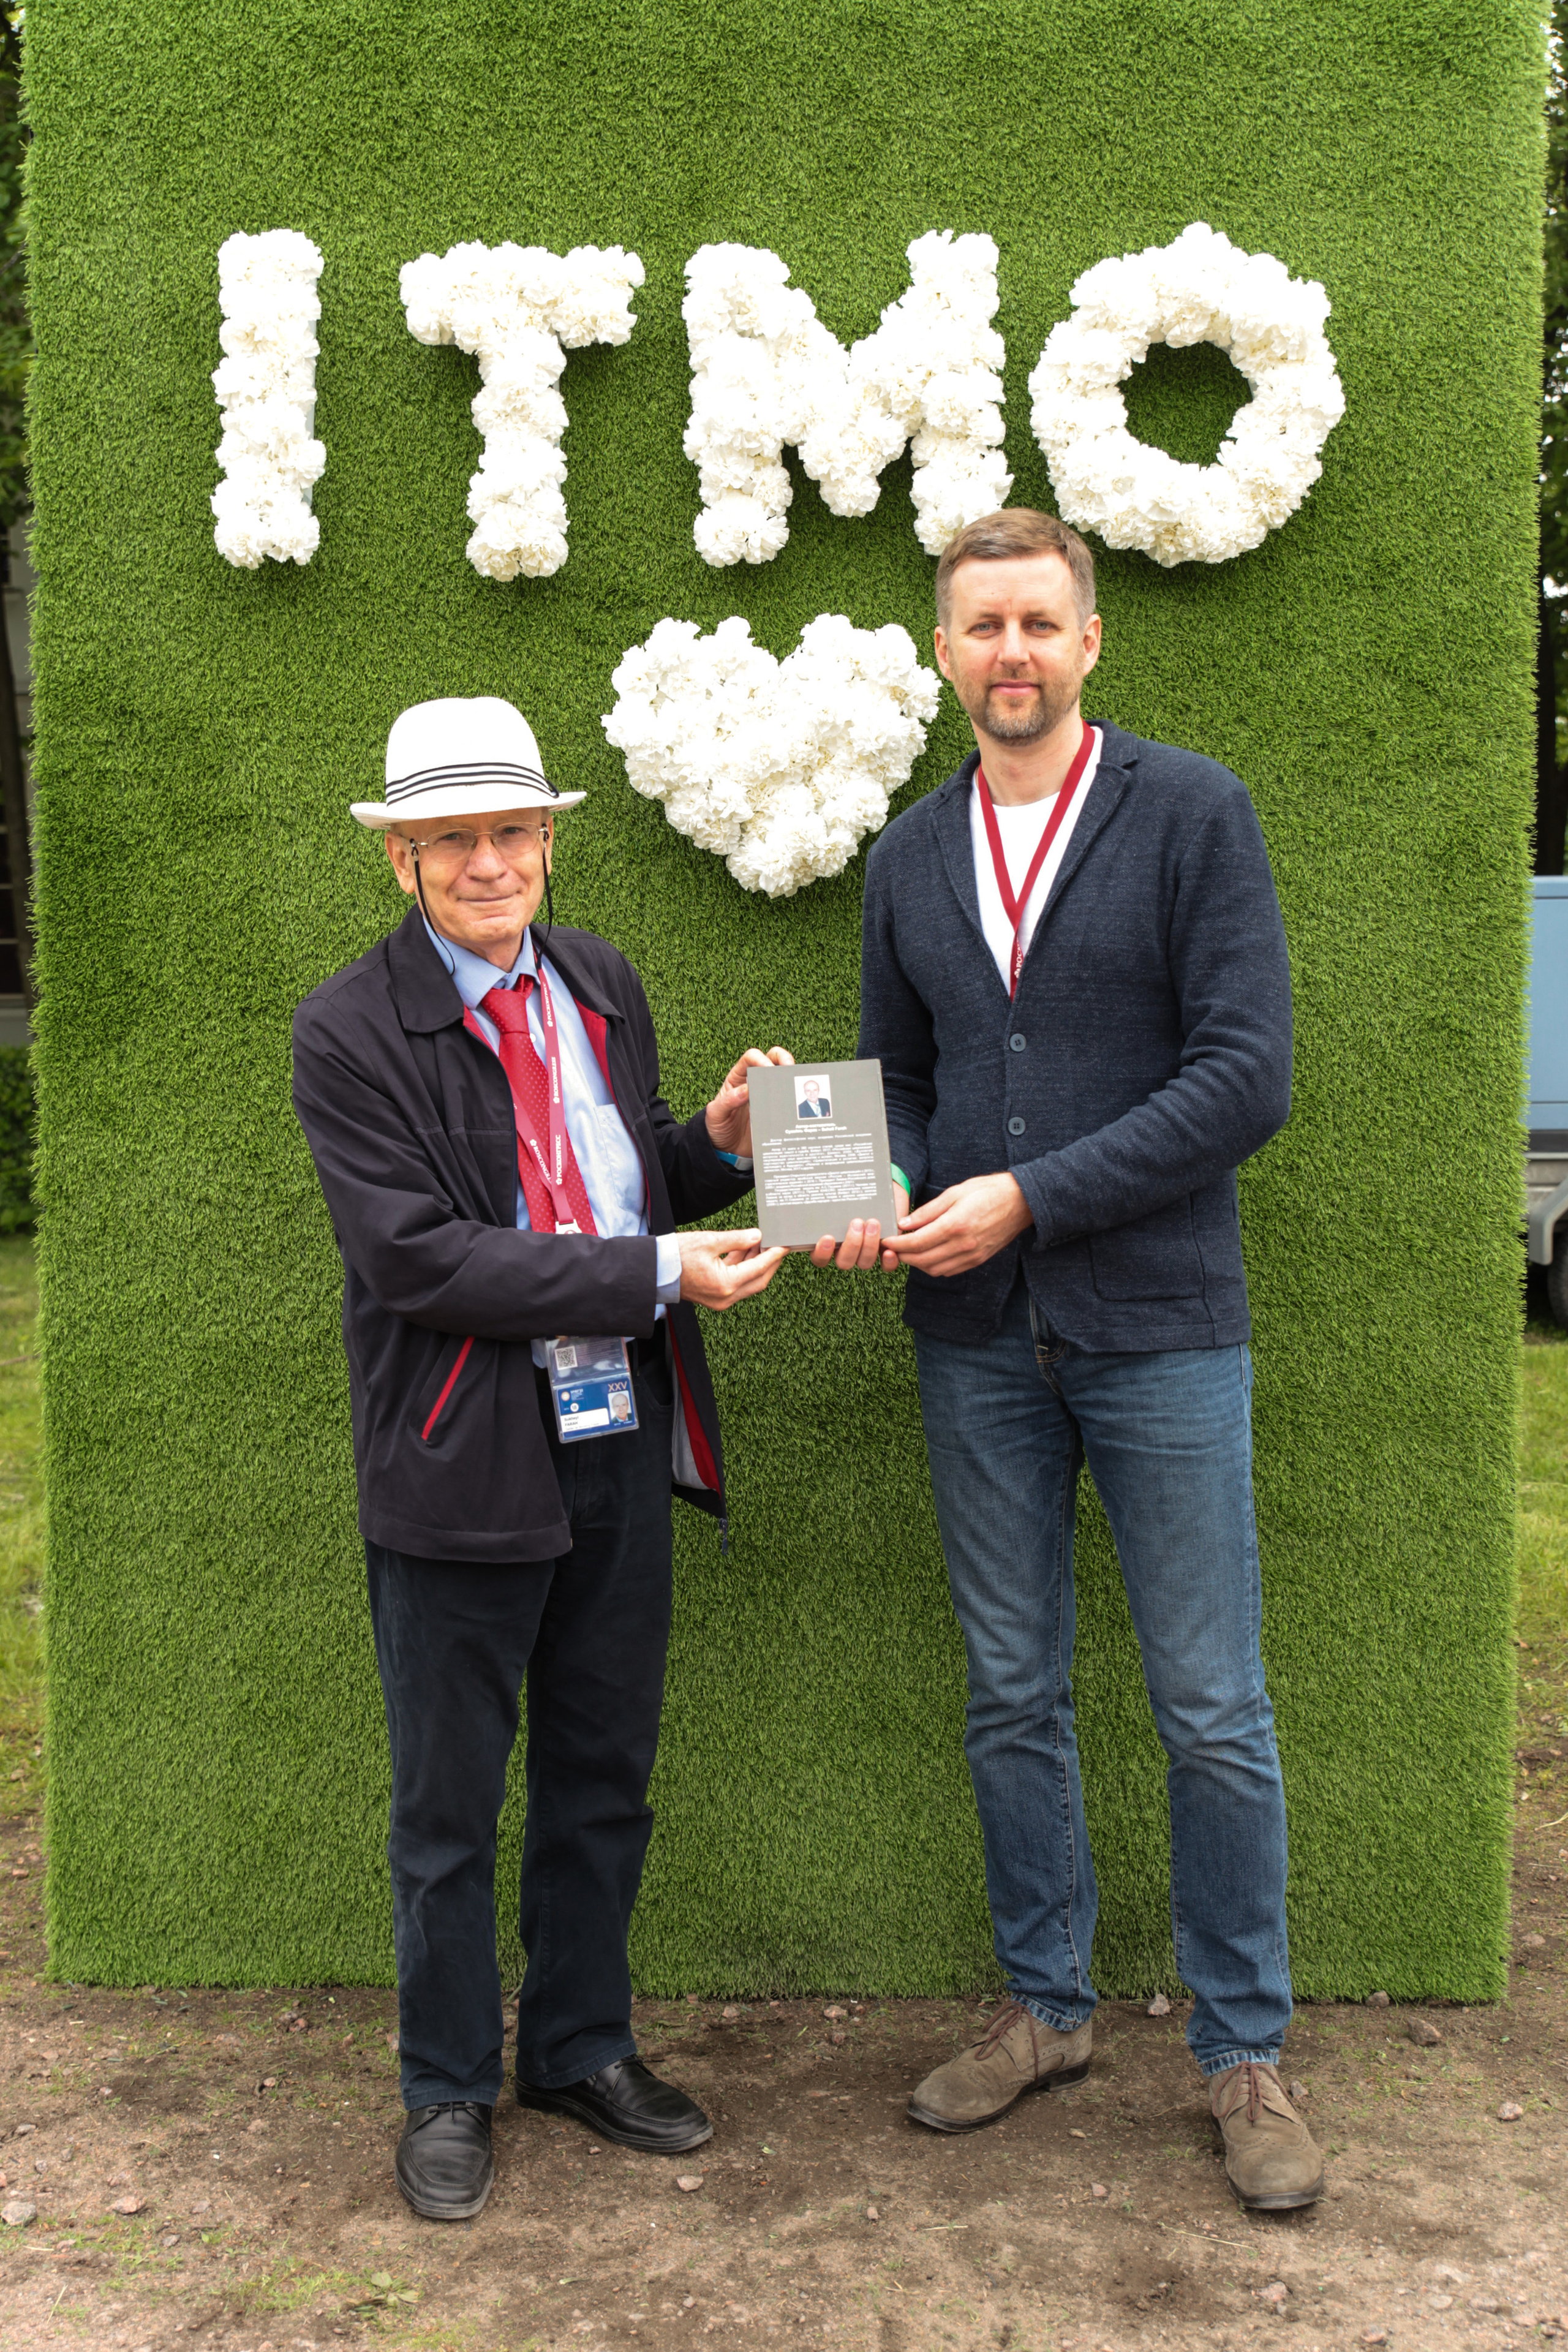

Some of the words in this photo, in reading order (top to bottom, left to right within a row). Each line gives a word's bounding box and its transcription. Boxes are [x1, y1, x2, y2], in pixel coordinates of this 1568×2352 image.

[211, 222, 1346, 582] ITMO
[533, 1146, 552, 1183] ROSCONGRE
[608, 1381, 627, 1392] XXV
